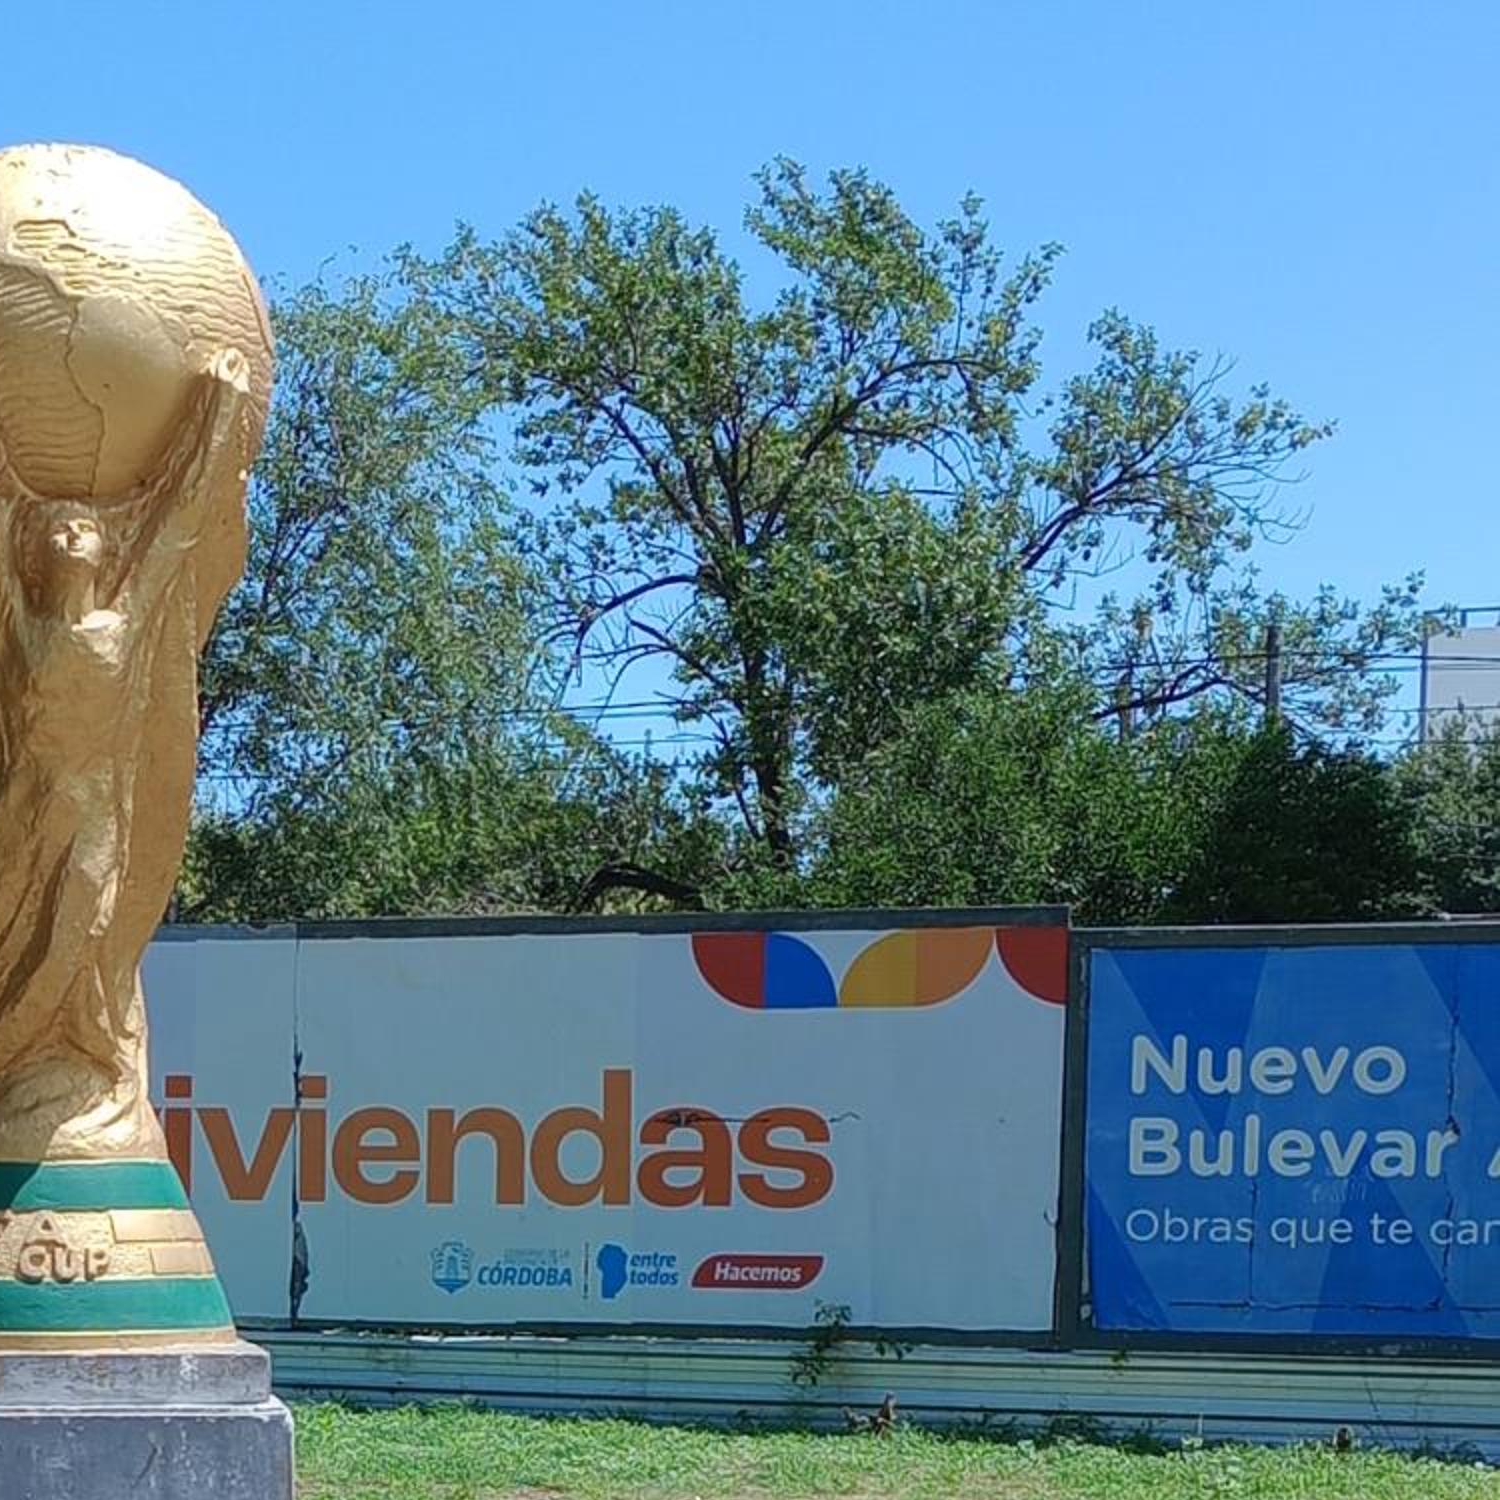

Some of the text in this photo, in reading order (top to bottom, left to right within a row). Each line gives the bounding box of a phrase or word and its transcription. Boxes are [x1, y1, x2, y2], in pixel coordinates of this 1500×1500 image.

[1131, 1034, 1407, 1094] Nuevo
[156, 1068, 835, 1208] iviendas
[1128, 1114, 1459, 1178] Bulevar
[1125, 1209, 1253, 1243] Obras
[1271, 1216, 1353, 1249] que
[1370, 1212, 1413, 1244] te
[17, 1244, 113, 1282] CUP
[477, 1261, 573, 1287] CÓRDOBA
[630, 1252, 677, 1268] entre
[630, 1268, 678, 1286] todos
[713, 1261, 801, 1283] Hacemos
